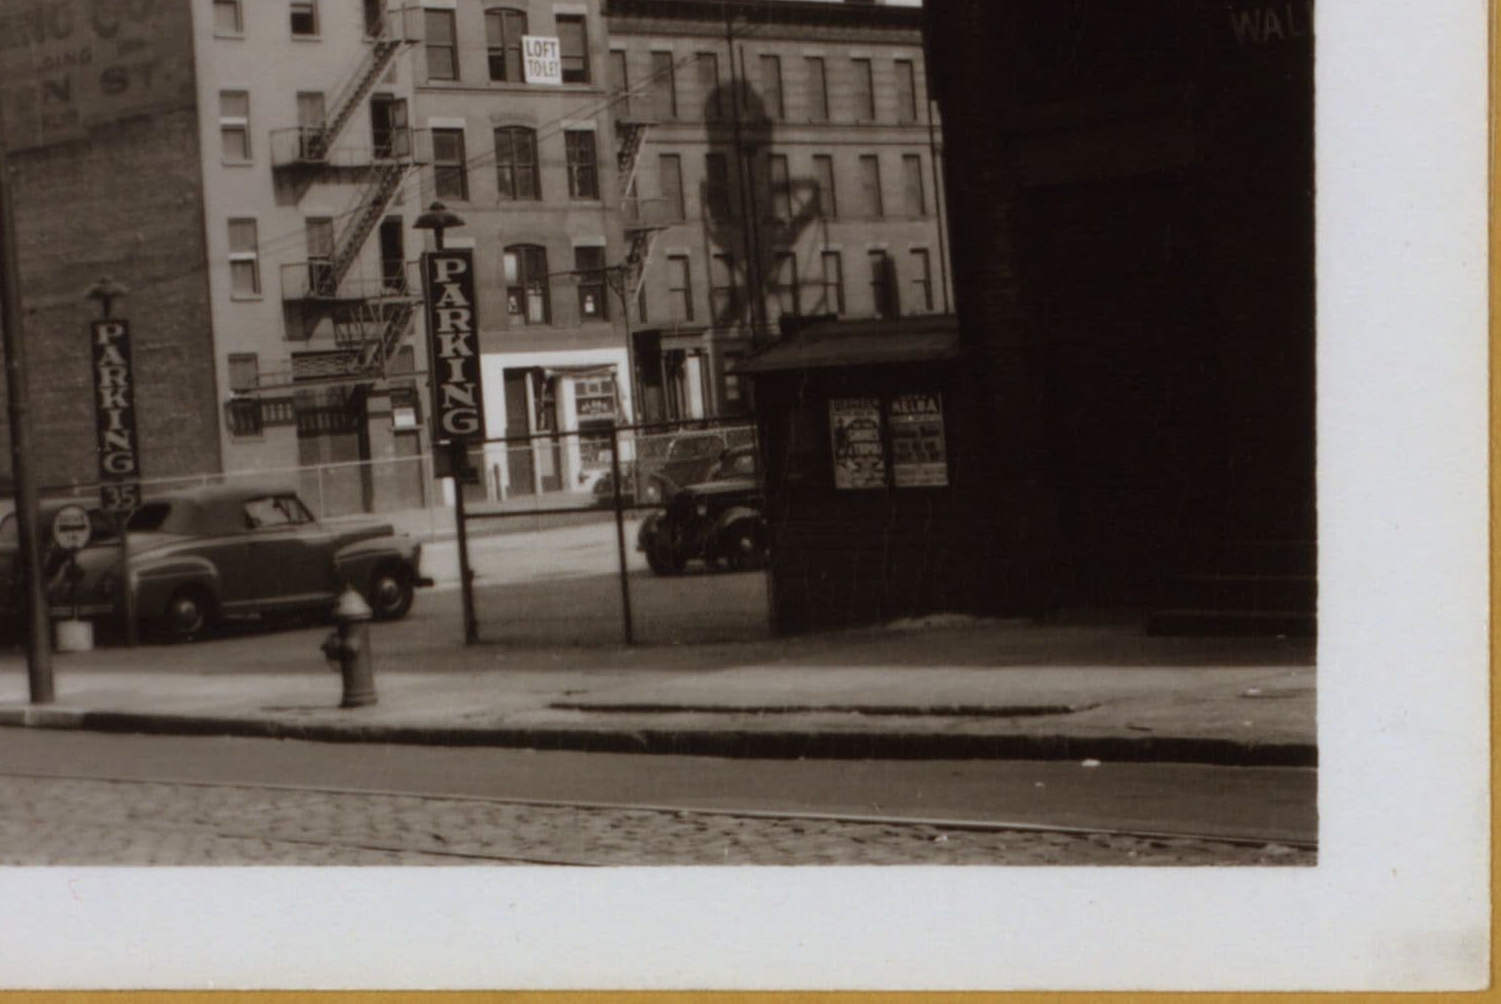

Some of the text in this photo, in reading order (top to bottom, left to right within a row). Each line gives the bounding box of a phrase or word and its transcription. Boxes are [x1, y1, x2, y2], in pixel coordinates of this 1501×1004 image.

[1229, 0, 1312, 46] WAL
[526, 39, 557, 59] LOFT
[434, 258, 480, 435] PARKING
[96, 323, 135, 474] PARKING
[105, 485, 137, 510] 35
